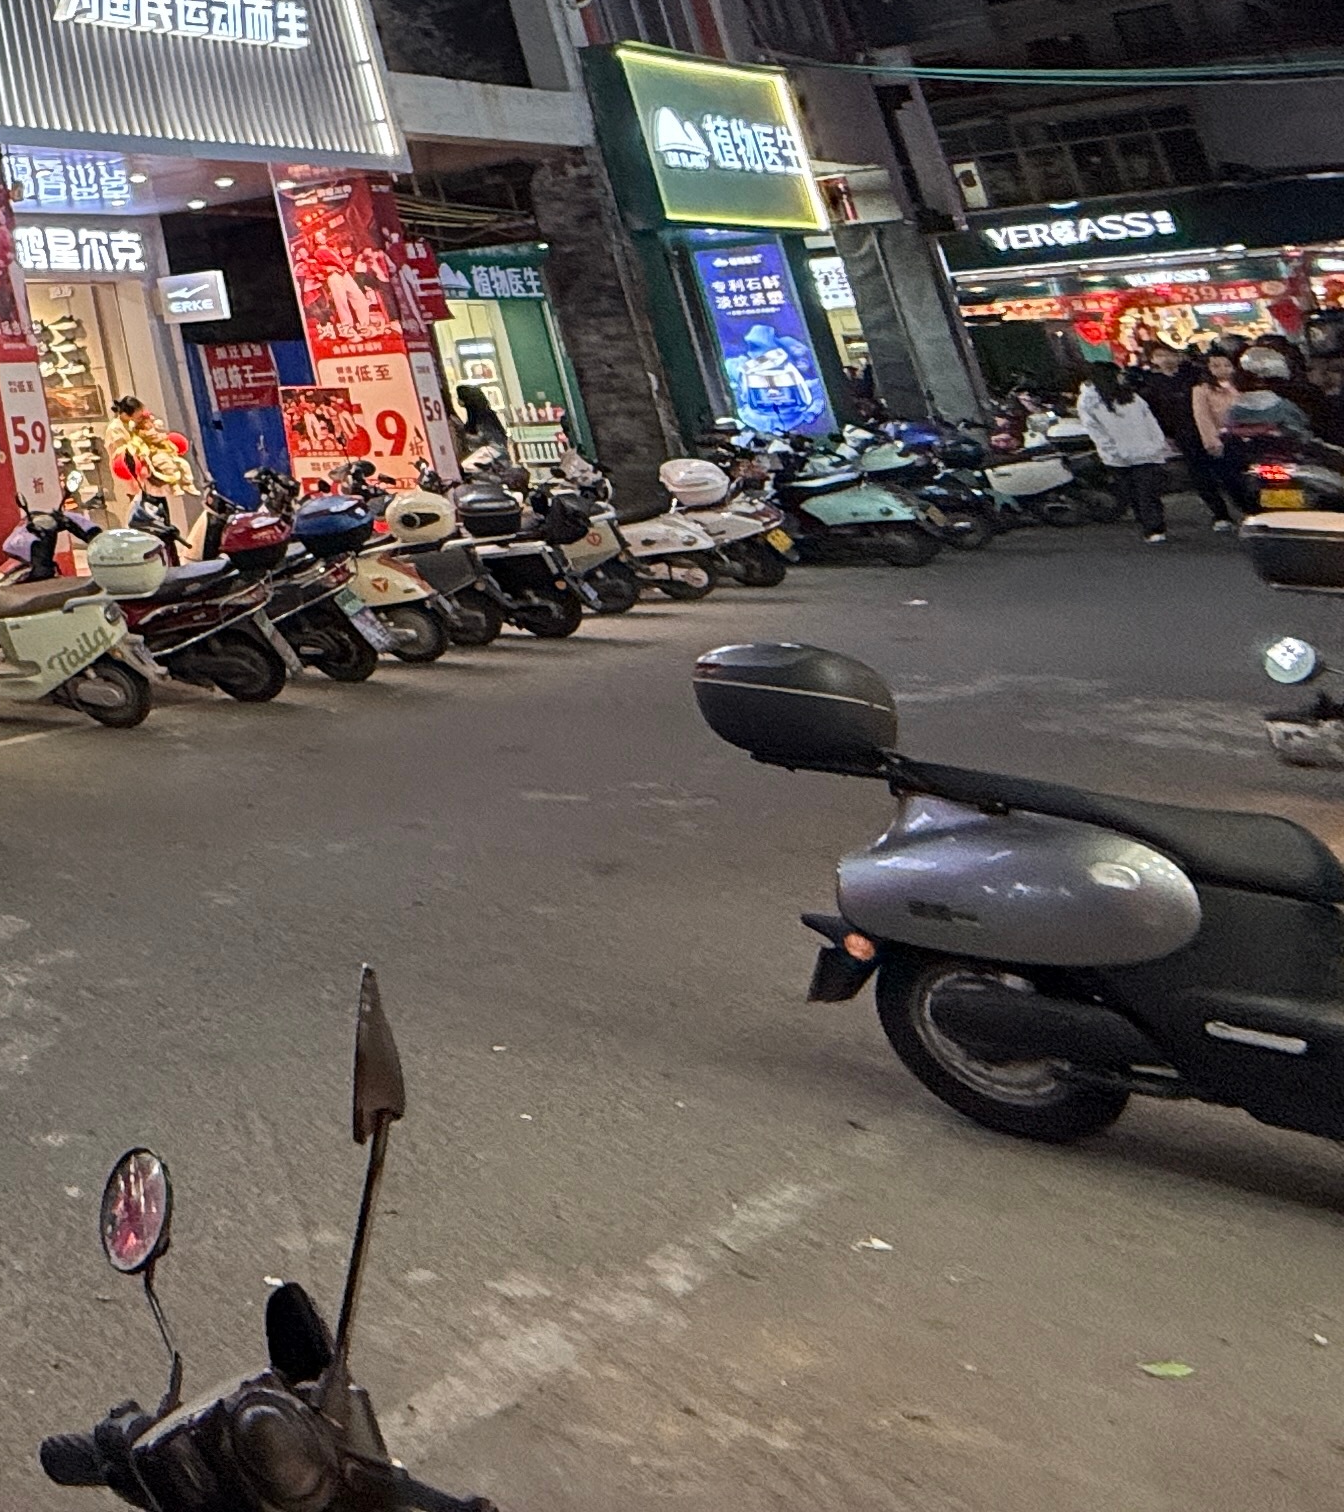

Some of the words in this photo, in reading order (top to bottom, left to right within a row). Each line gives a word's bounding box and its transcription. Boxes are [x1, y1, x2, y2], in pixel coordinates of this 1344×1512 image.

[701, 113, 810, 176] 植物医生
[13, 226, 147, 272] 鸿星尔克
[470, 264, 545, 298] 植物医生
[169, 298, 215, 314] ERKE
[355, 364, 393, 383] 低至
[11, 416, 48, 456] 5.9
[32, 477, 45, 495] 折
